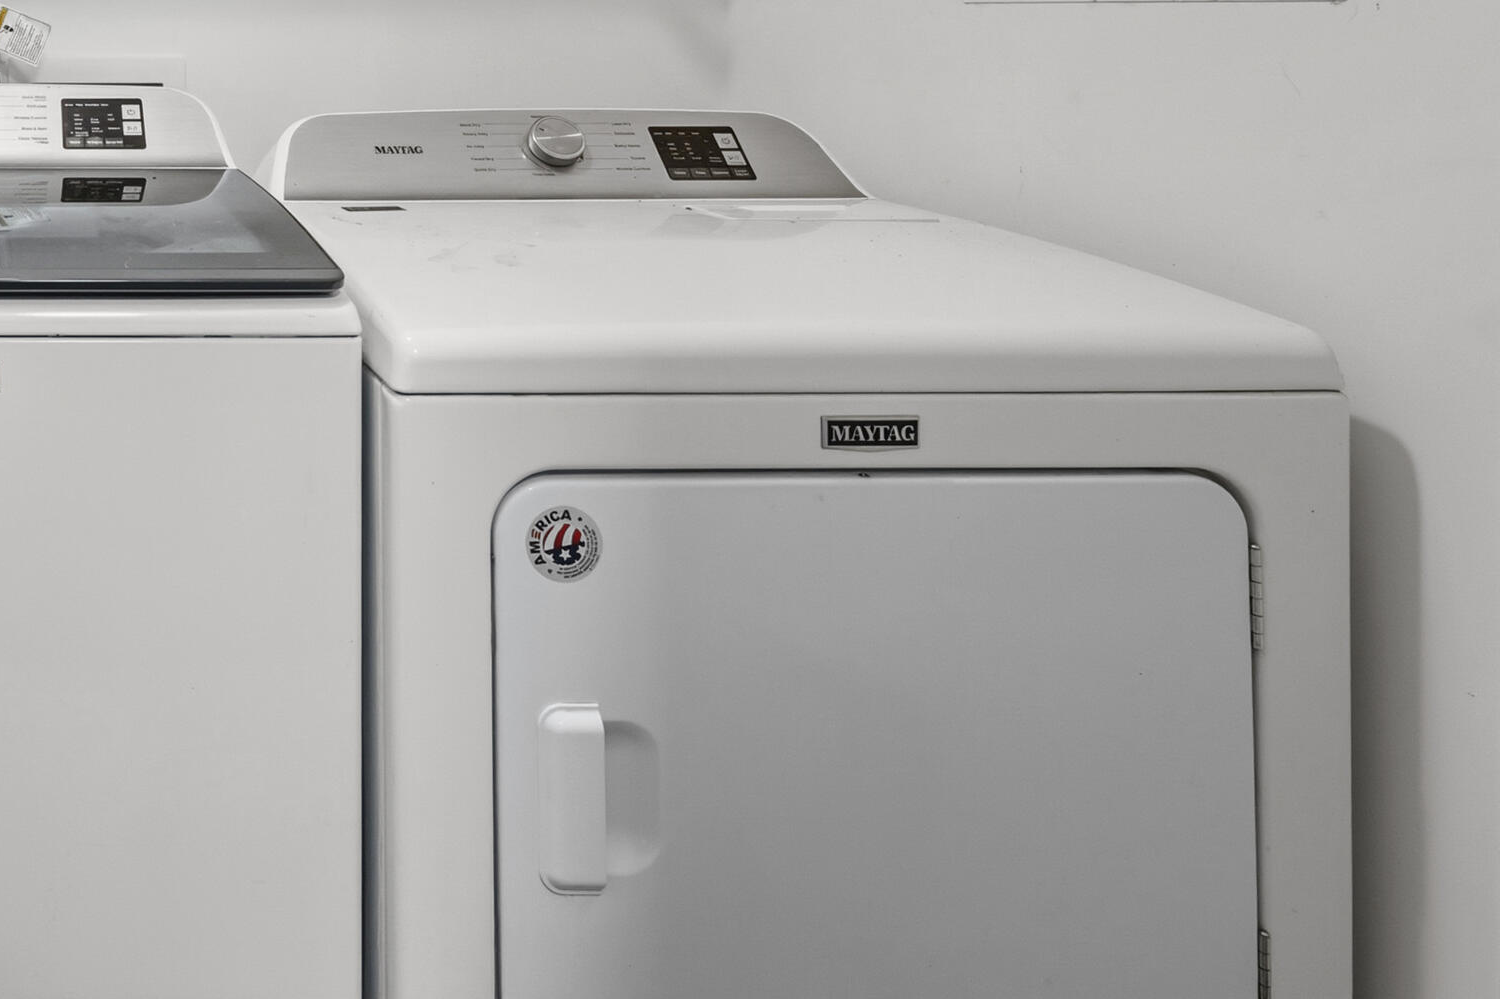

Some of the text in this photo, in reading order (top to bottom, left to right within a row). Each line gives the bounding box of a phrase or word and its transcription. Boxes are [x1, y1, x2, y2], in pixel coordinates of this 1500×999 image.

[374, 145, 424, 154] MAYTAG
[831, 425, 915, 441] MAYTAG
[529, 509, 572, 565] AMERICA
